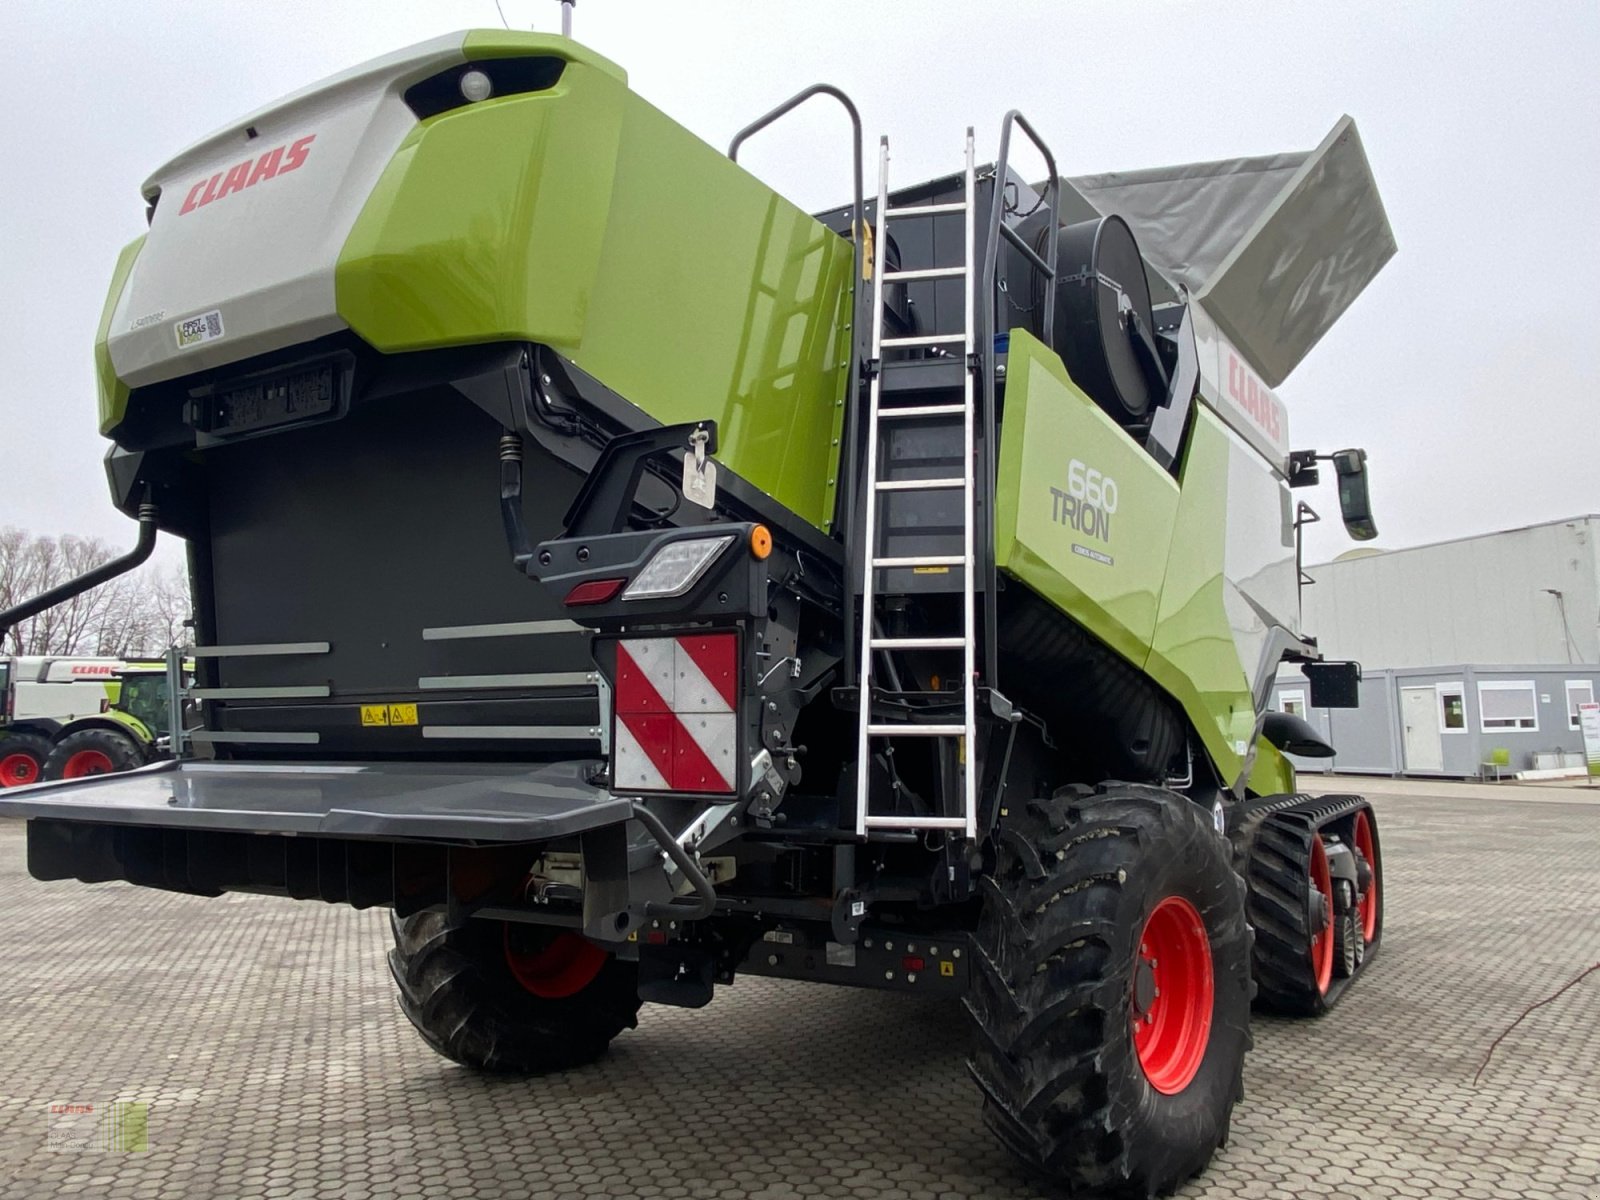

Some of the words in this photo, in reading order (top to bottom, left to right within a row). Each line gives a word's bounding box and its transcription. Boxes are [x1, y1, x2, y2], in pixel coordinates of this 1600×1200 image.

[178, 134, 317, 216] CLAAS
[183, 324, 207, 338] CLAAS
[1228, 353, 1280, 442] CLAAS
[1050, 486, 1109, 543] TRION
[1068, 458, 1118, 514] 660
